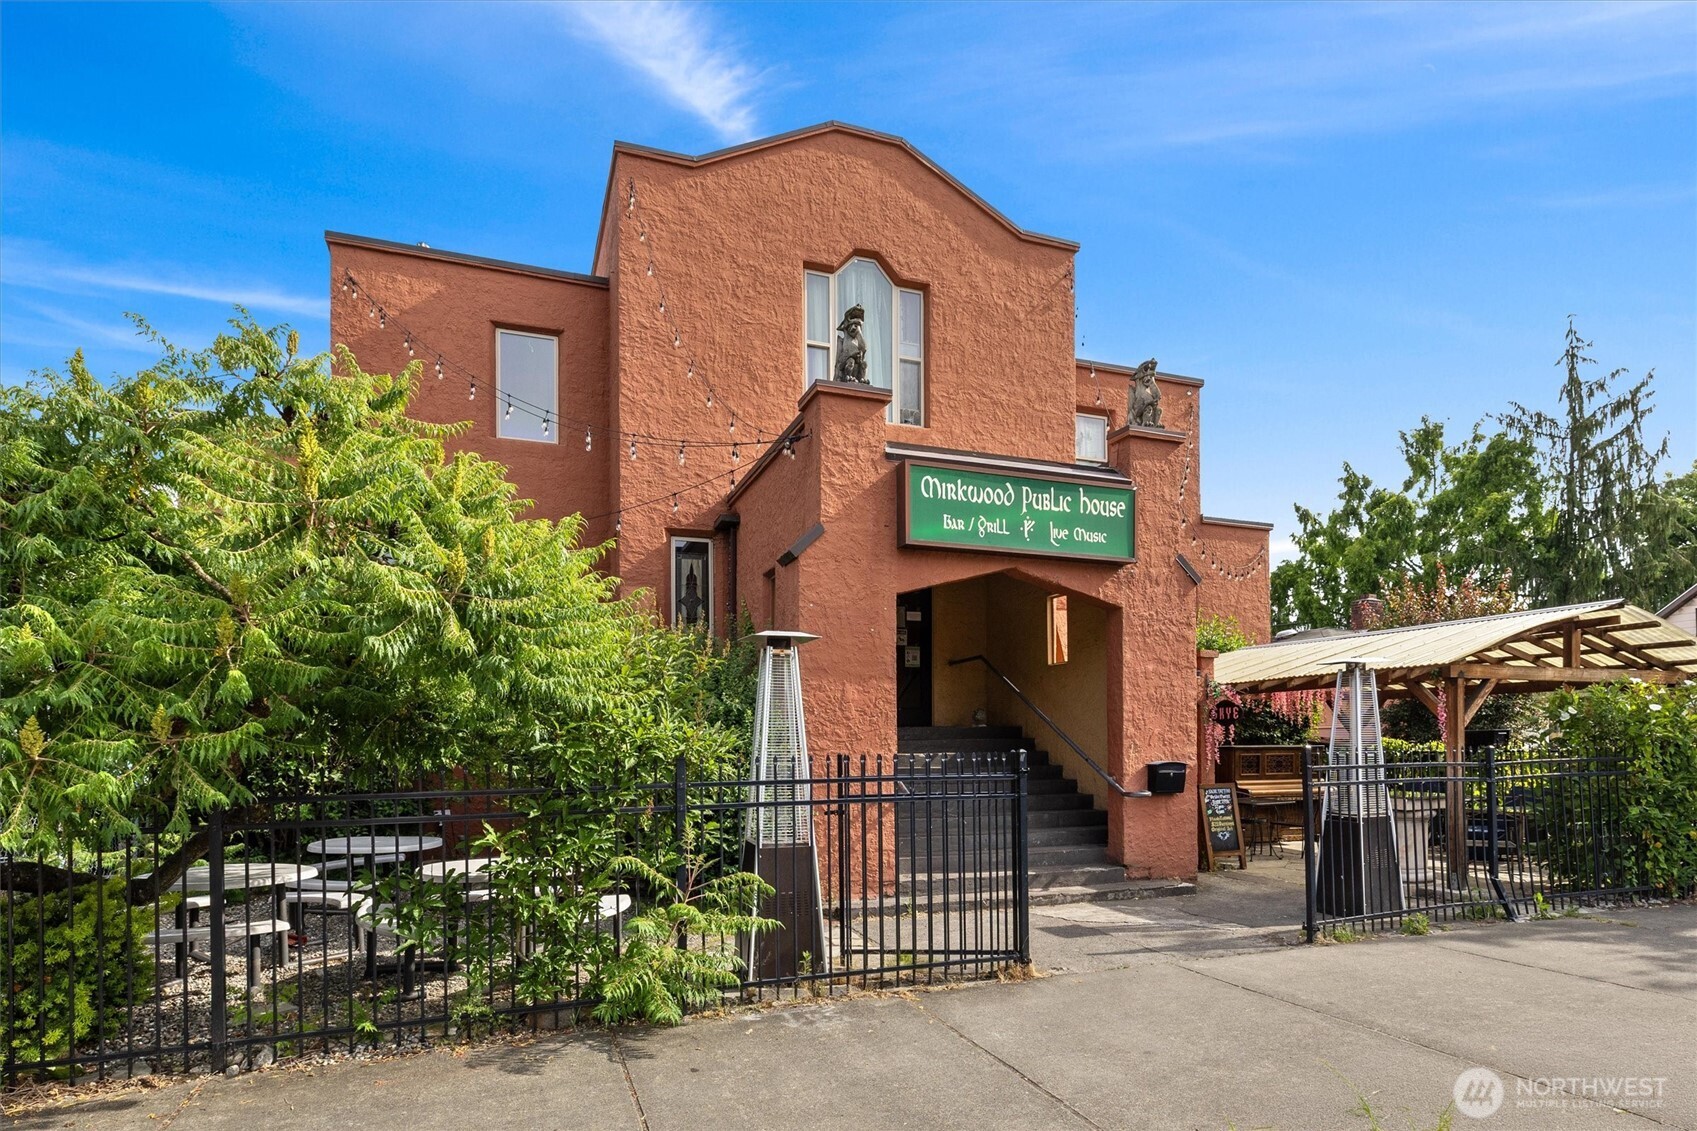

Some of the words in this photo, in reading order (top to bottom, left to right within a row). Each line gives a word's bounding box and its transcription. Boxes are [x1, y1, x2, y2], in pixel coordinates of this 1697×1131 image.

[921, 475, 1014, 506] Mirkwood
[1020, 486, 1072, 515] Public
[943, 514, 965, 531] Bar
[977, 515, 1010, 538] Grill
[1050, 521, 1069, 547] Live
[1074, 527, 1107, 543] Music
